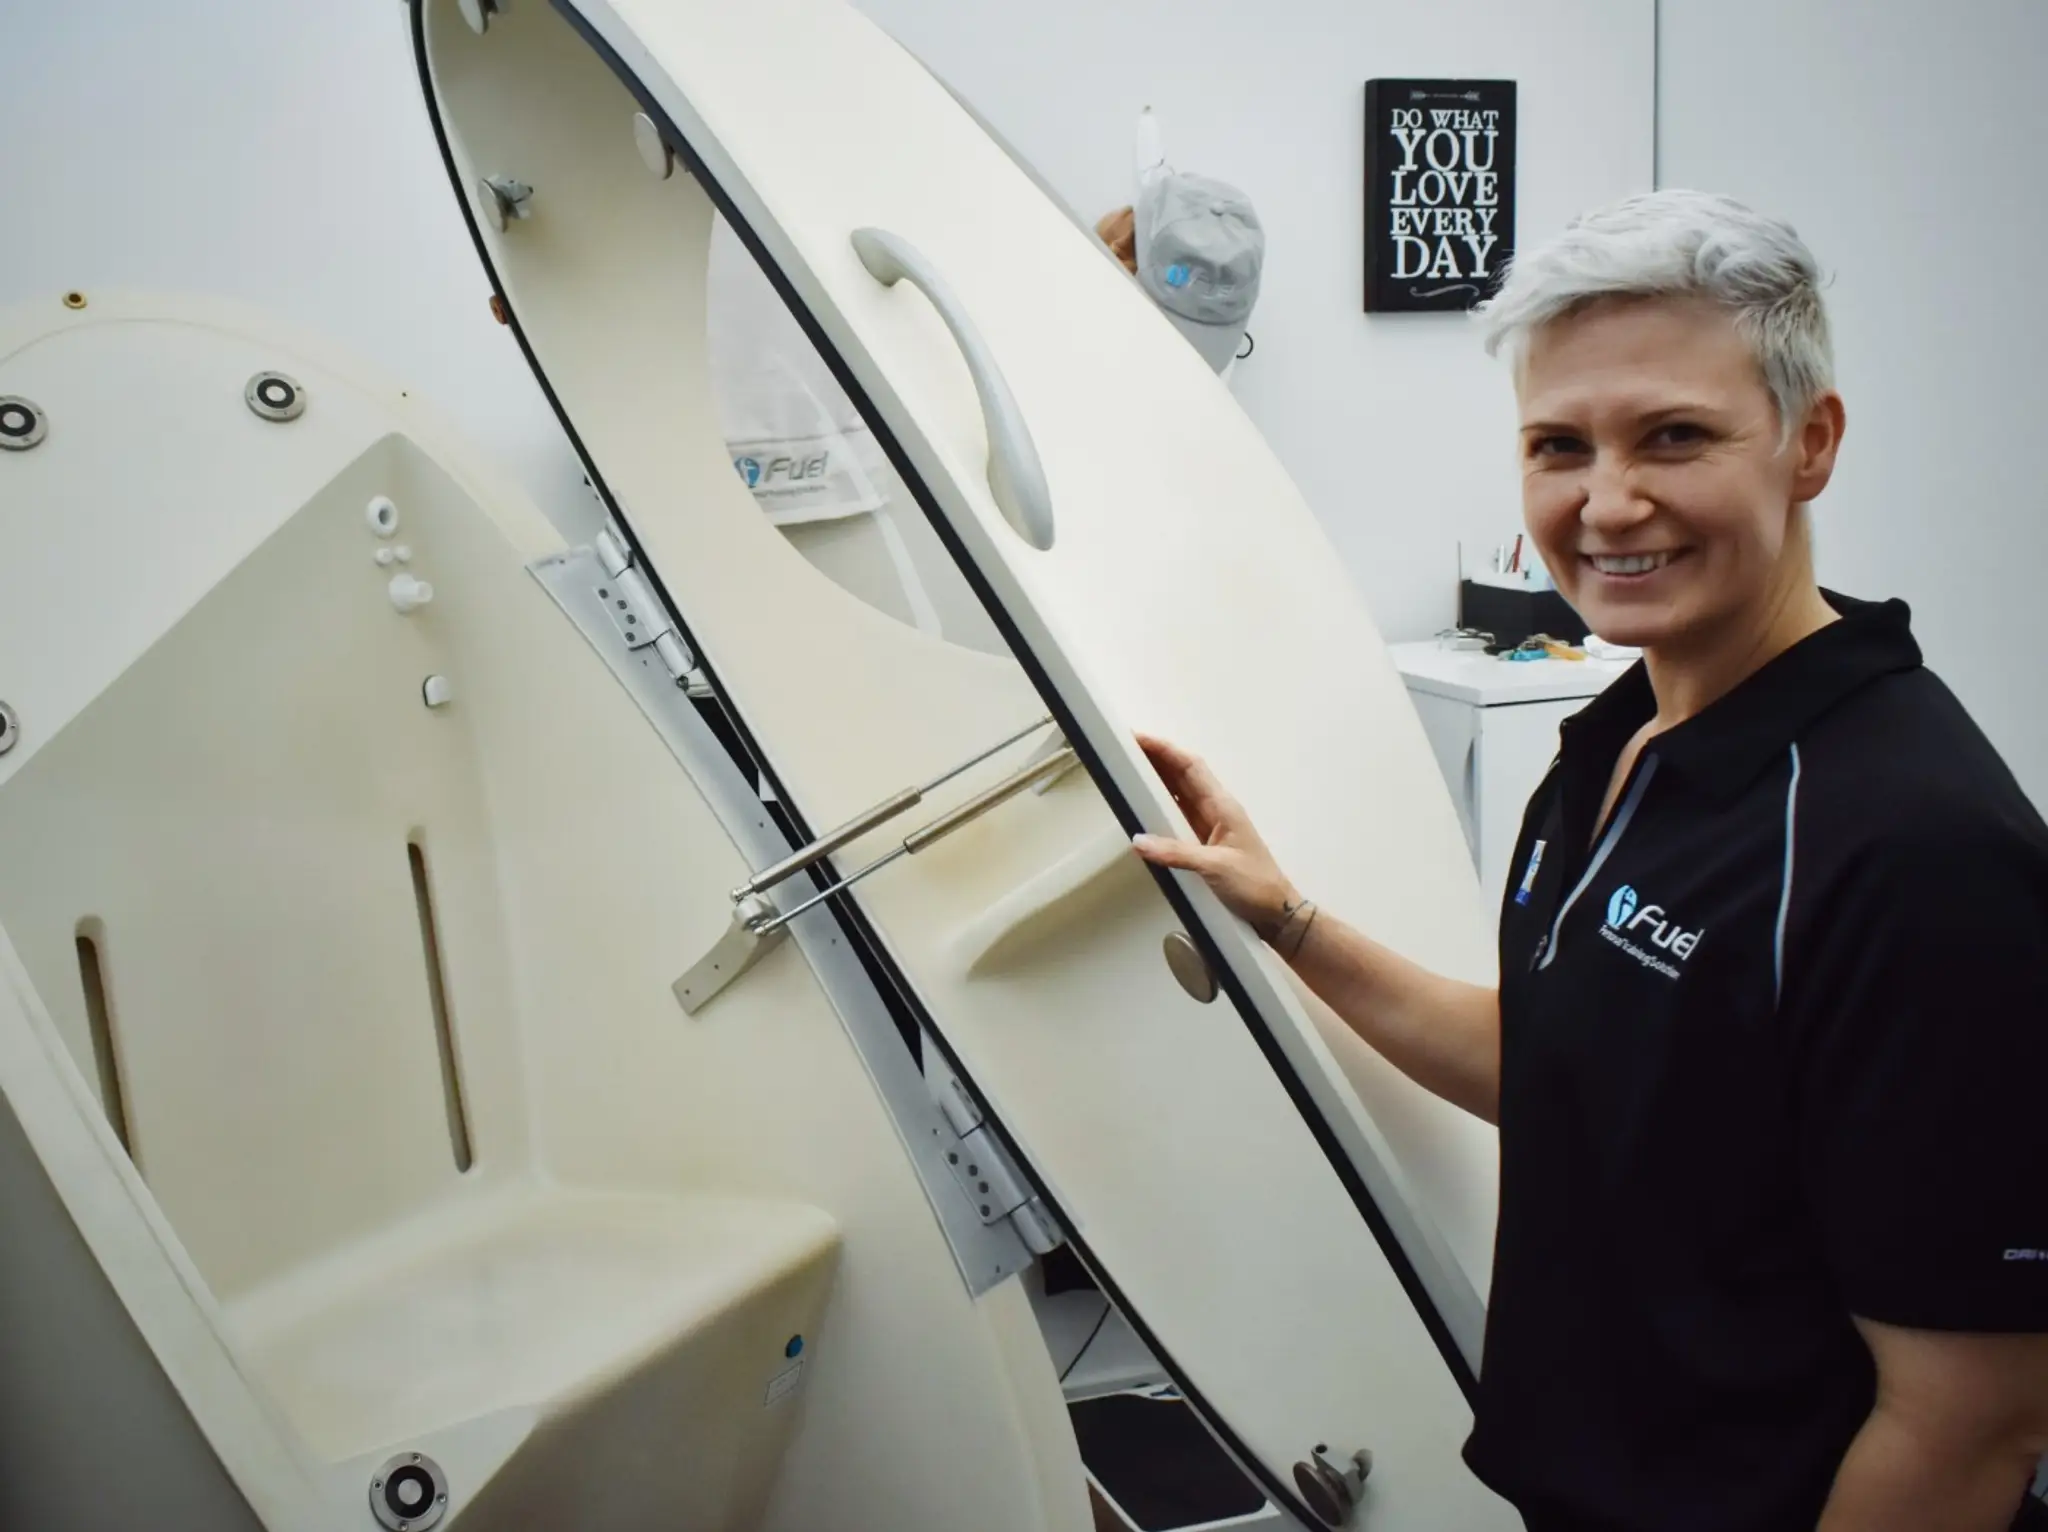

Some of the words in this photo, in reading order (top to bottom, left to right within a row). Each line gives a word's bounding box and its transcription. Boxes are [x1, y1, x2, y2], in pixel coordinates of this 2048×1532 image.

[1391, 108, 1422, 128] DO
[1429, 109, 1499, 129] WHAT
[1390, 128, 1499, 172] YOU
[1390, 170, 1498, 206] LOVE
[1390, 207, 1498, 236] EVERY
[1390, 235, 1498, 279] DAY
